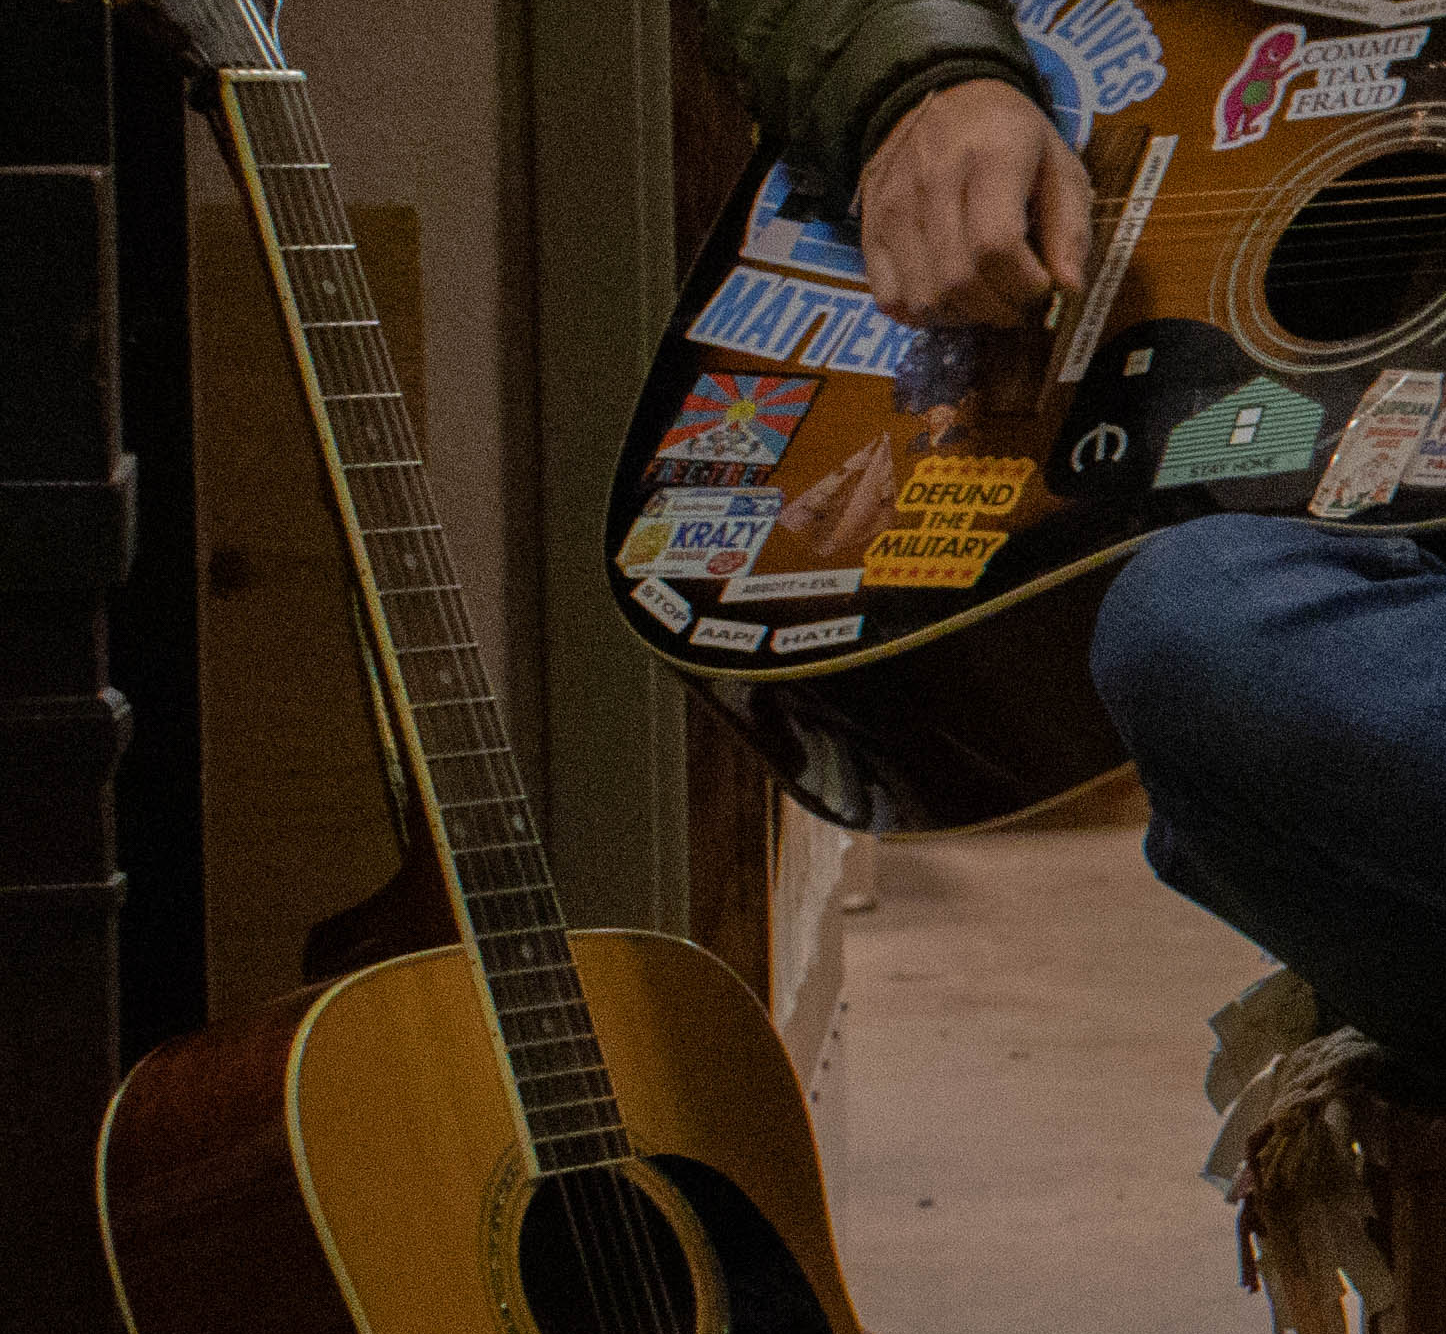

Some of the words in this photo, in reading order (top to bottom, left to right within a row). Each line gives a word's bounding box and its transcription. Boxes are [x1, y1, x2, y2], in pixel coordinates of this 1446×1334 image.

[1302, 32, 1421, 64] COMMIT
[1322, 62, 1382, 87] TAX
[1295, 82, 1401, 114] FRAUD
[903, 481, 1015, 506] DEFUND
[928, 510, 969, 530] THE
[670, 520, 767, 549] KRAZY
[870, 533, 998, 559] MILITARY
[639, 583, 690, 623] STOP
[699, 624, 757, 646] AAPI
[781, 624, 856, 647] HATE
